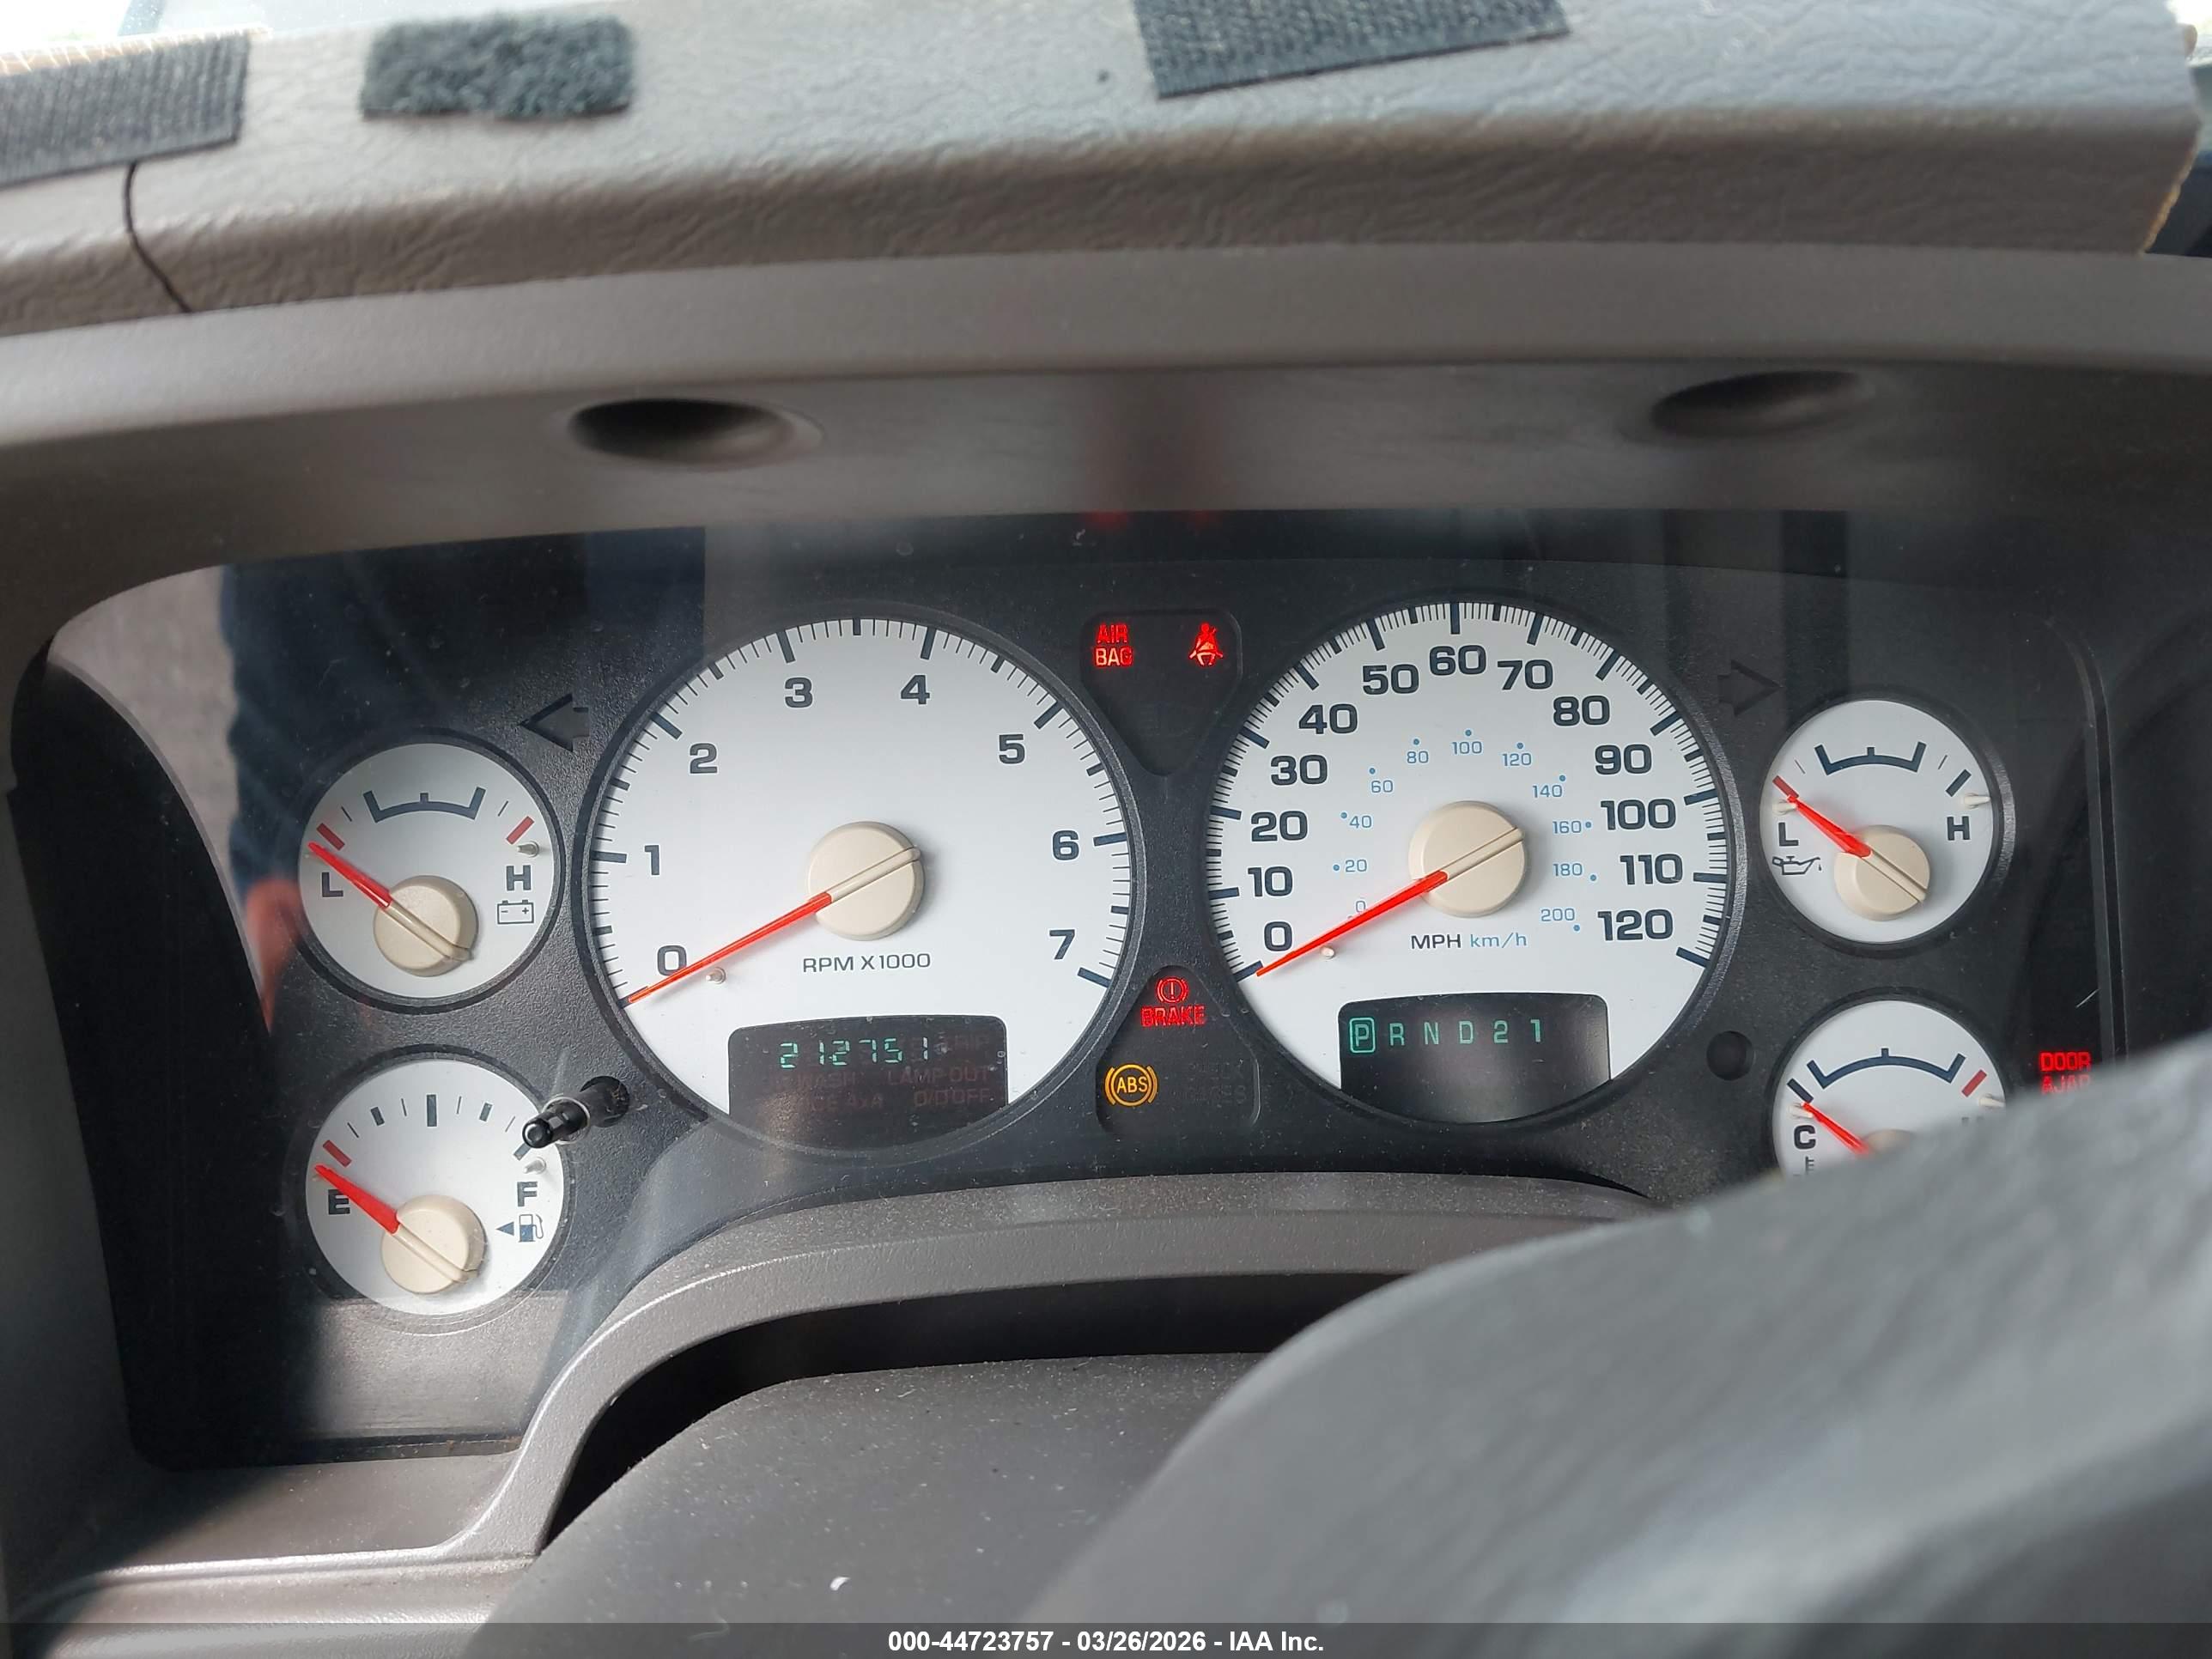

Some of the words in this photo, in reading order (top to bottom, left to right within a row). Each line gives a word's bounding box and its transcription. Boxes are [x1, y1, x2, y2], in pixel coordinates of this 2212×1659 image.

[1097, 624, 1127, 643] AIR
[1096, 647, 1133, 665] BAG
[1430, 645, 1486, 676] 60
[1363, 664, 1419, 695] 50
[1498, 659, 1553, 690] 70
[785, 678, 812, 708] 3
[901, 675, 930, 704] 4
[1299, 704, 1358, 734] 40
[1553, 696, 1609, 726] 80
[690, 744, 717, 774] 2
[1000, 734, 1024, 763] 5
[1407, 750, 1429, 763] 80
[1451, 741, 1482, 755] 100
[1502, 753, 1532, 767] 120
[1595, 744, 1651, 775] 90
[1271, 755, 1327, 786] 30
[1371, 780, 1393, 794] 60
[1533, 785, 1562, 798] 140
[1251, 811, 1307, 842] 20
[1349, 814, 1372, 829] 40
[1601, 799, 1675, 830] 100
[1553, 821, 1582, 836] 160
[1778, 823, 1798, 846] L
[1948, 816, 1970, 841] H
[1053, 830, 1079, 860] 6
[645, 845, 659, 875] 1
[1346, 860, 1367, 872] 20
[1553, 863, 1583, 876] 180
[1620, 854, 1682, 884] 110
[322, 872, 343, 897] L
[507, 865, 531, 890] H
[1248, 866, 1292, 896] 10
[1541, 908, 1575, 921] 200
[1598, 909, 1673, 940] 120
[1049, 929, 1075, 959] 7
[1264, 921, 1292, 951] 0
[1412, 934, 1461, 949] MPH
[1471, 933, 1527, 948] km/h
[658, 945, 687, 975] 0
[804, 957, 853, 972] RPM
[861, 954, 930, 969] X1000
[1142, 1006, 1205, 1026] BRAKE
[1355, 1024, 1369, 1046] P
[1390, 1024, 1404, 1045] R
[1424, 1022, 1440, 1045] N
[1459, 1020, 1474, 1044] D
[1494, 1021, 1508, 1043] 2
[1531, 1019, 1540, 1042] 1
[2040, 1053, 2089, 1071] DOOR
[1117, 1077, 1148, 1094] ABS
[1794, 1125, 1815, 1149] C
[328, 1189, 350, 1215] E
[517, 1182, 538, 1206] F
